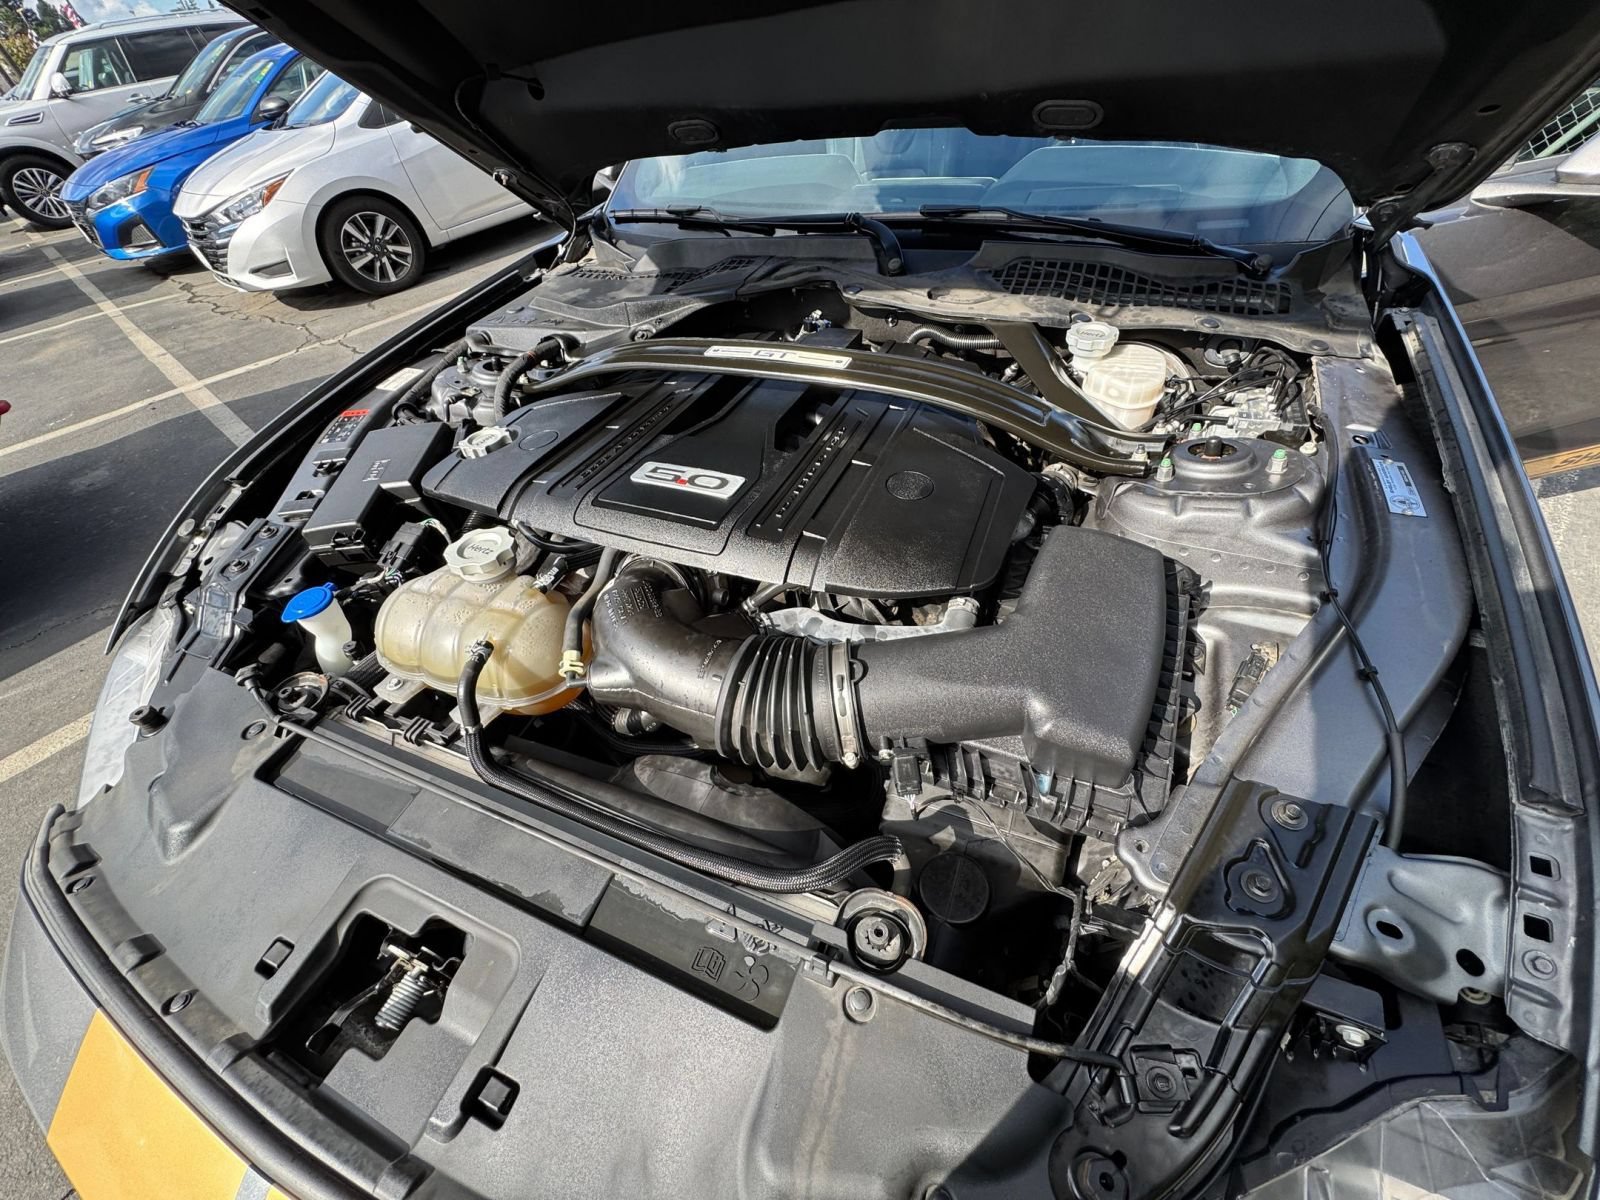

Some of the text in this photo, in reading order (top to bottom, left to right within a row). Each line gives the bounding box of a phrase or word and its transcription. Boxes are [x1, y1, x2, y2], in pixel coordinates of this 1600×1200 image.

[753, 349, 797, 359] GT
[644, 466, 730, 490] 5.0
[467, 543, 495, 555] Hertz
